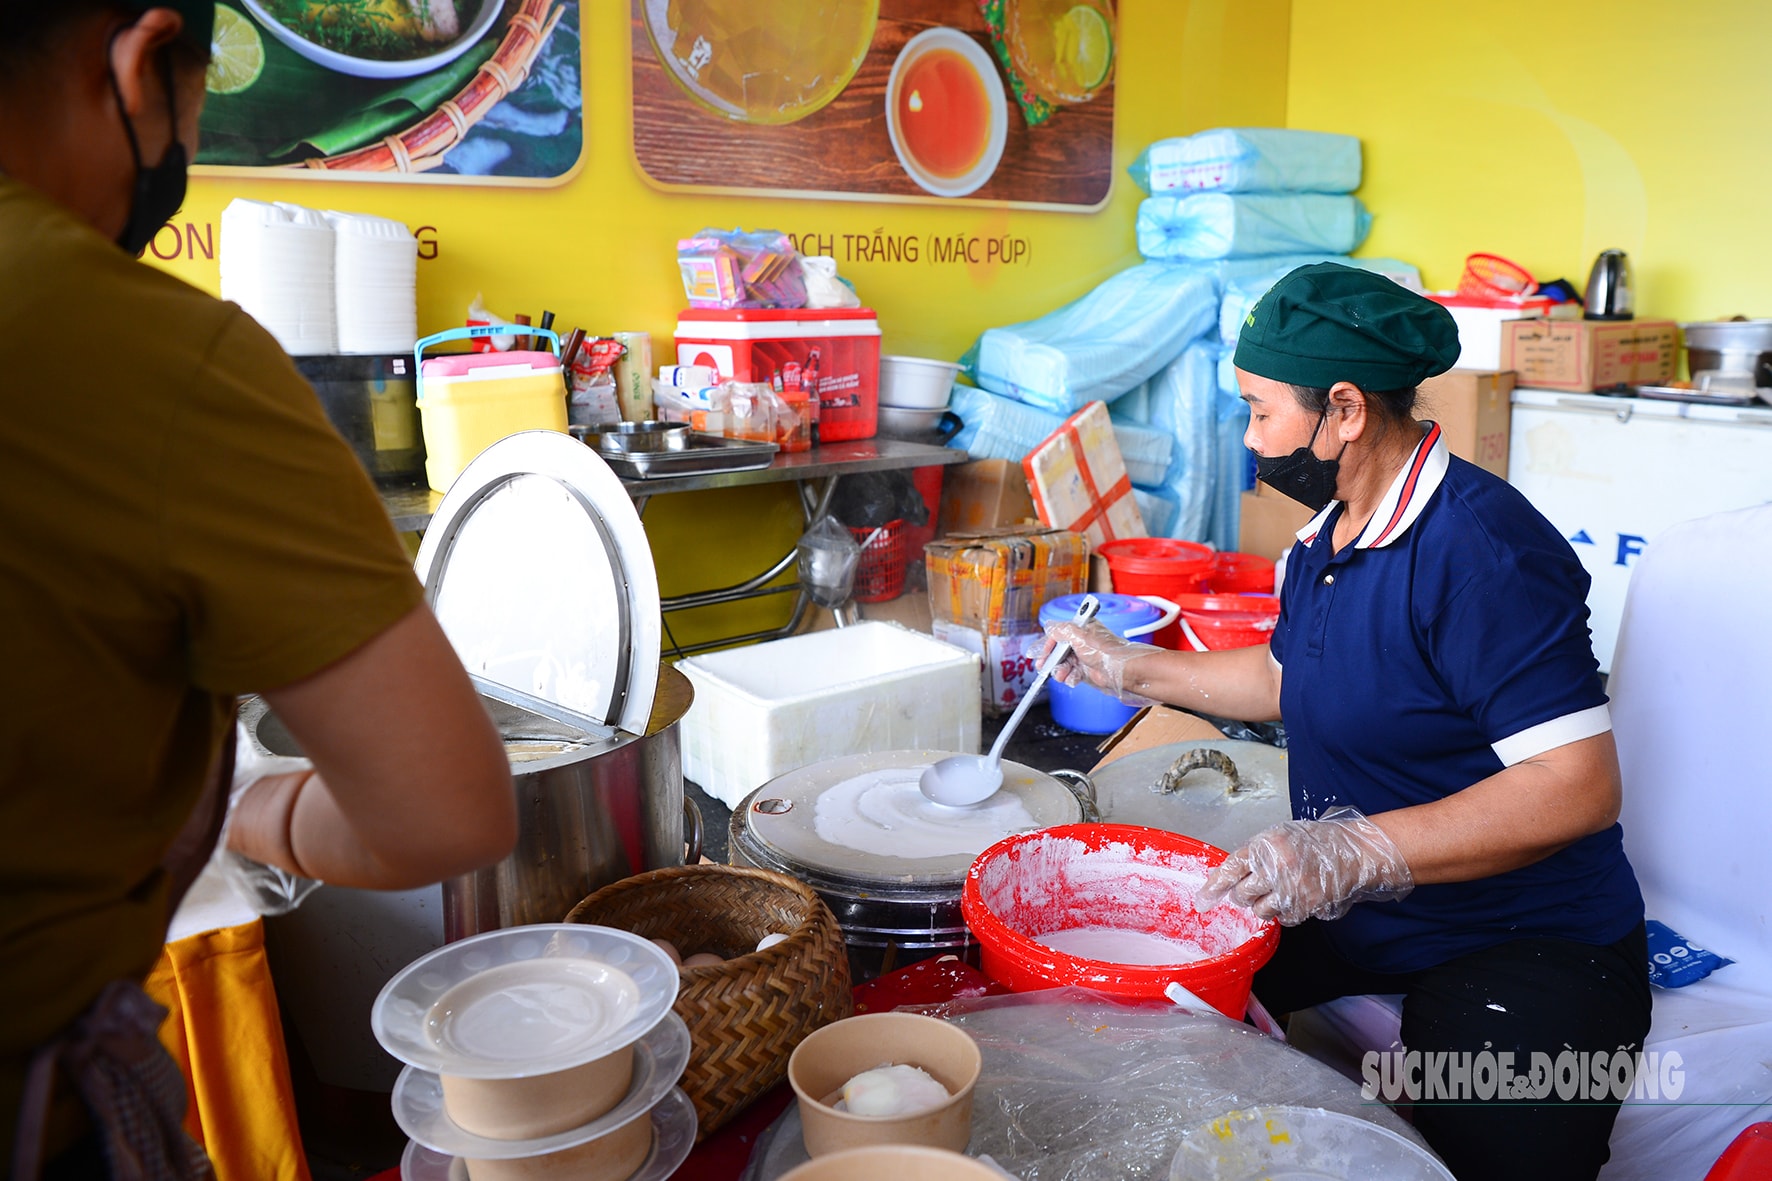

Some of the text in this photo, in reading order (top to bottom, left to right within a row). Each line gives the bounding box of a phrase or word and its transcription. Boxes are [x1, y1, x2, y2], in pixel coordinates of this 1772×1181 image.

[842, 226, 919, 263] TRẮNG
[926, 232, 981, 266] (MÁC
[987, 233, 1033, 267] PÚP)
